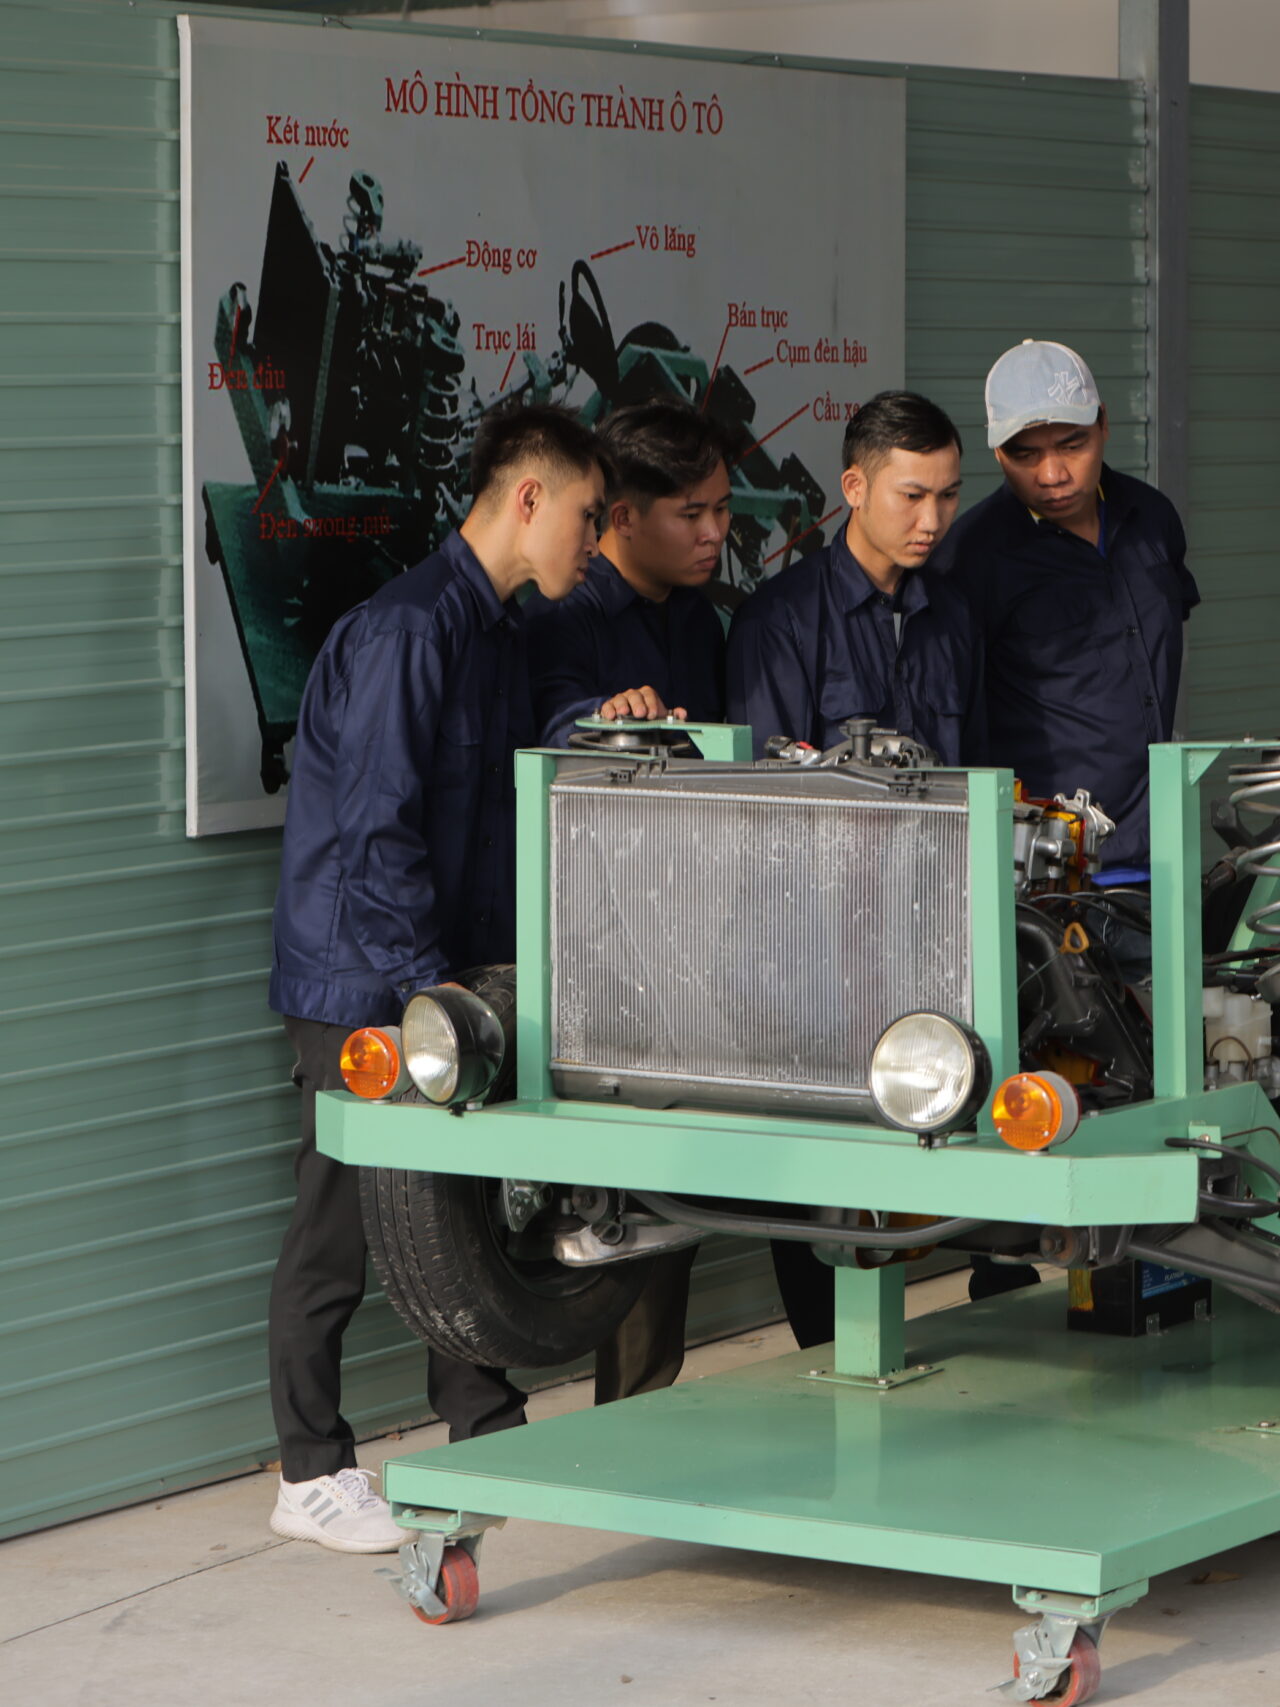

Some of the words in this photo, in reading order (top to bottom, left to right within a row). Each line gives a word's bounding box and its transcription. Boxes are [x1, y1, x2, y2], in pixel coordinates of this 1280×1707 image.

[385, 70, 428, 115] MÔ
[434, 72, 500, 120] HÌNH
[506, 78, 575, 126] TỔNG
[581, 85, 665, 132] THÀNH
[670, 90, 687, 133] Ô
[692, 93, 723, 136] TÔ
[266, 115, 300, 145] Két
[305, 118, 349, 148] nước
[466, 239, 512, 275] Động
[517, 247, 538, 269] cơ
[636, 224, 659, 251] Vô
[664, 224, 696, 259] lăng
[728, 301, 757, 328] Bán
[761, 305, 788, 333] trục
[472, 323, 511, 355] Trục
[516, 322, 536, 351] lái
[776, 339, 811, 368] Cụm
[814, 337, 840, 364] đèn
[843, 337, 867, 368] hậu
[813, 391, 841, 422] Cầu
